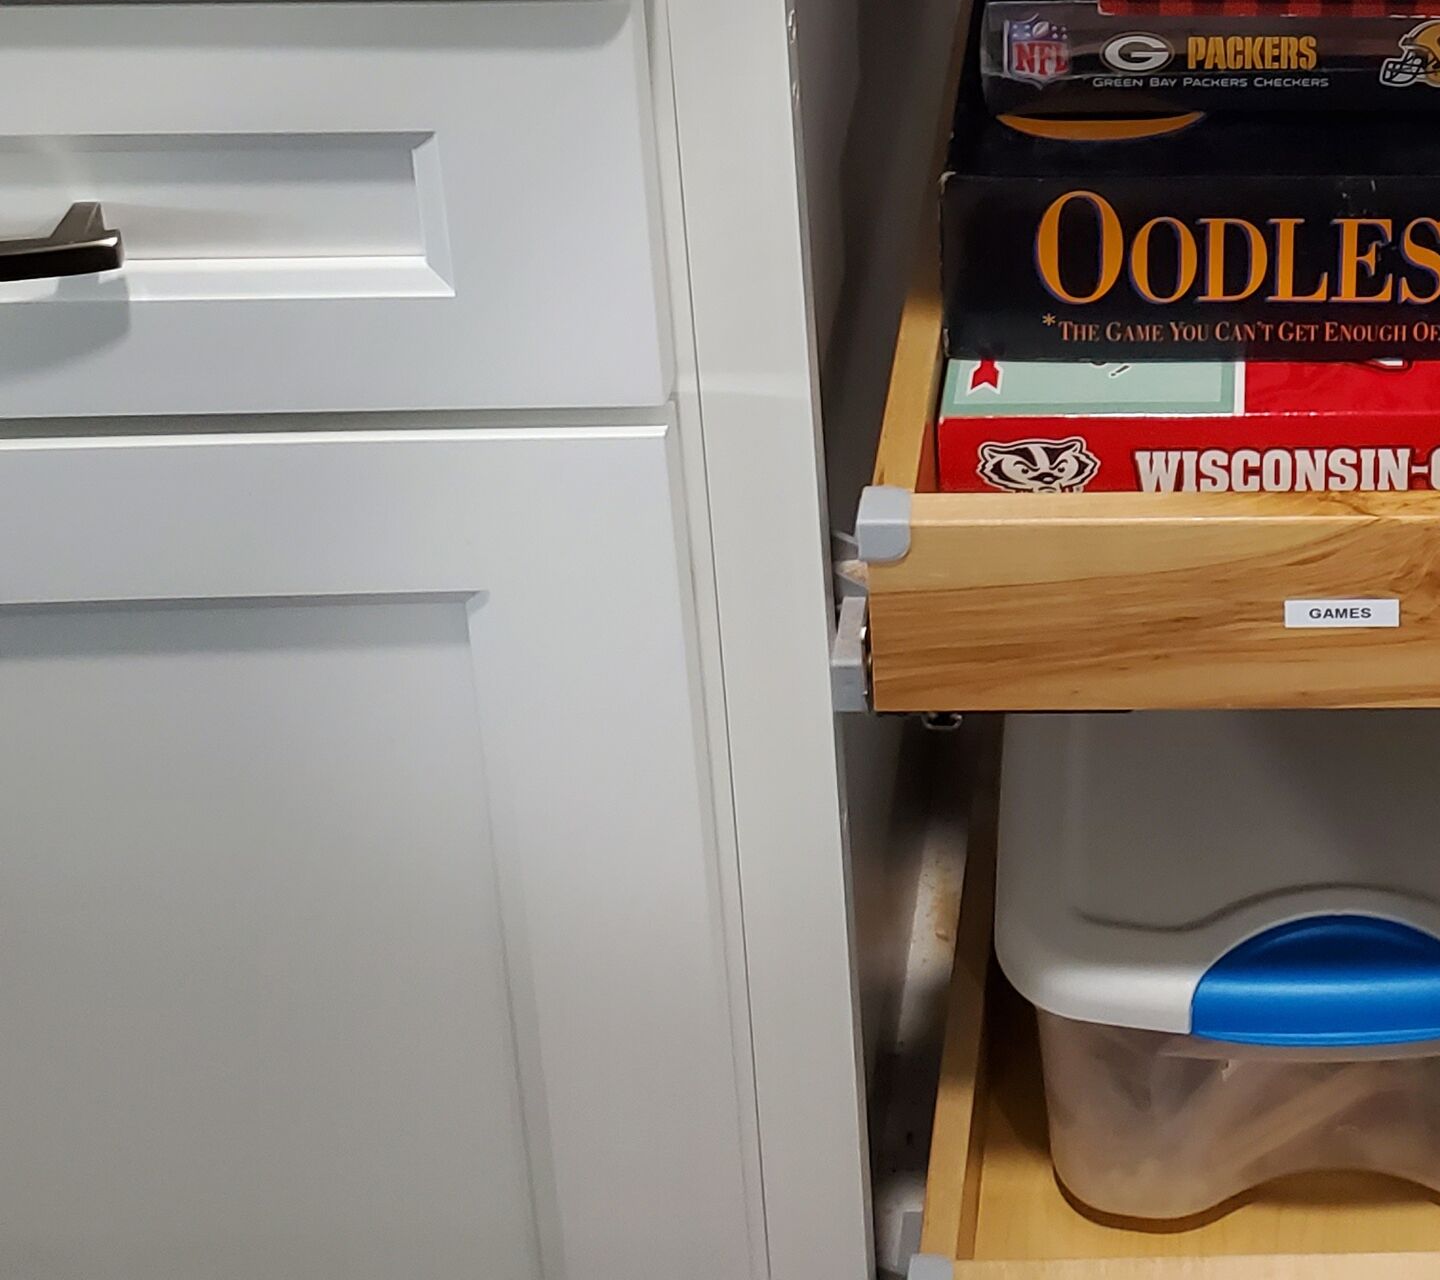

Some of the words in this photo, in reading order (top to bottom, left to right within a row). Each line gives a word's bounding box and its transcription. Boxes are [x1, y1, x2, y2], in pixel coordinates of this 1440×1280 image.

[1015, 42, 1069, 76] NFL
[1187, 35, 1317, 71] PACKERS
[1092, 77, 1145, 88] GREEN
[1149, 77, 1178, 88] BAY
[1182, 77, 1248, 88] PACKERS
[1253, 77, 1329, 88] CHECKERS
[1105, 321, 1164, 342] GAME
[1169, 321, 1208, 341] YOU
[1213, 321, 1274, 342] CAN'T
[1278, 322, 1318, 342] GET
[1324, 322, 1407, 342] ENOUGH
[1309, 608, 1372, 619] GAMES
